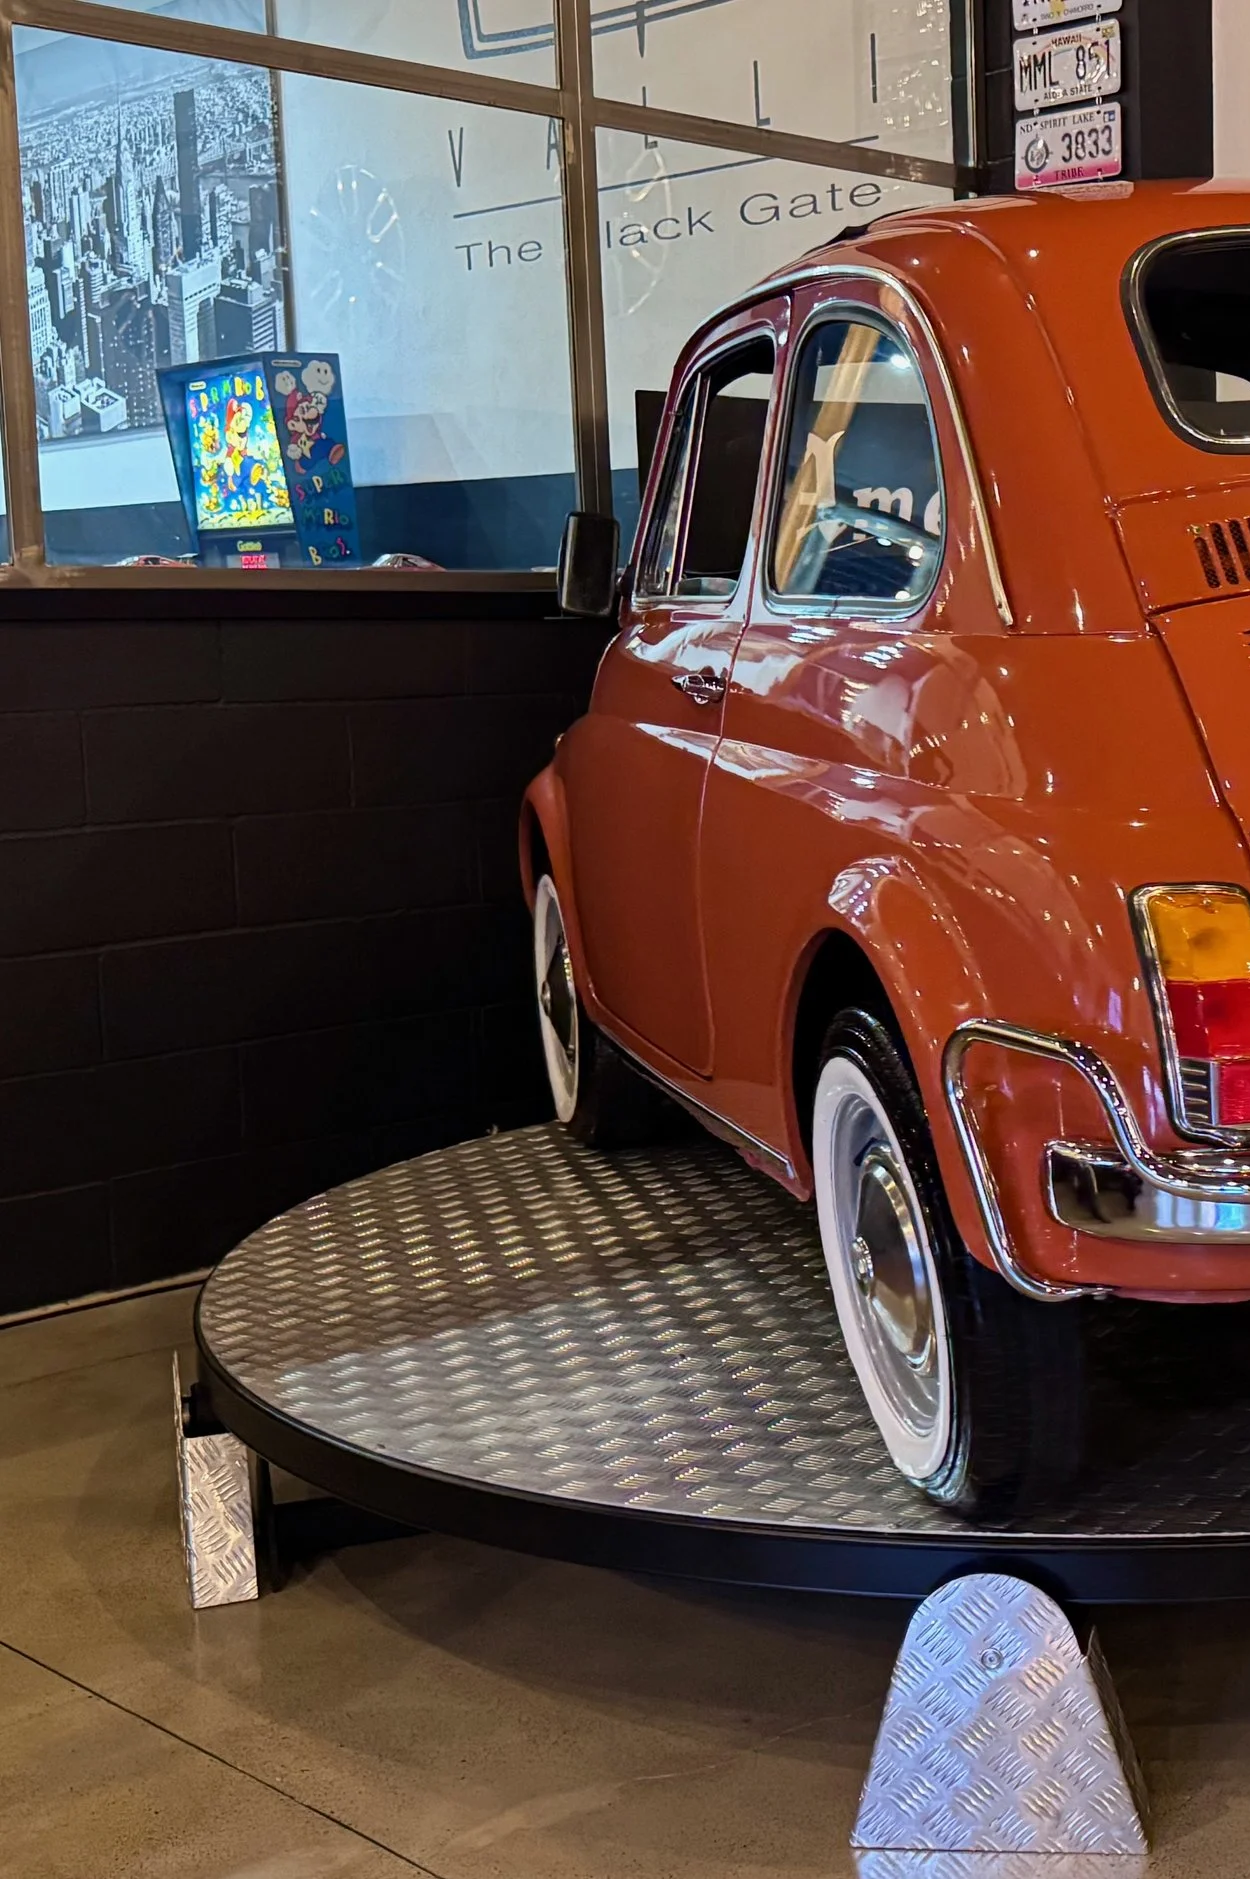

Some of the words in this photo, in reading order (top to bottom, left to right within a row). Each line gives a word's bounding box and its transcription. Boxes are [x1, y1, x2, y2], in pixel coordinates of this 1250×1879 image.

[1019, 51, 1059, 93] MML
[1043, 88, 1068, 100] ALOA
[1070, 83, 1092, 96] STATE
[1020, 124, 1033, 134] ND
[1040, 117, 1068, 129] SPIRIT
[1072, 112, 1094, 125] LAKE
[1061, 125, 1112, 163] 3833
[1055, 166, 1084, 181] TRIBE
[454, 240, 543, 271] The
[605, 206, 714, 249] lack
[739, 181, 882, 226] Gate
